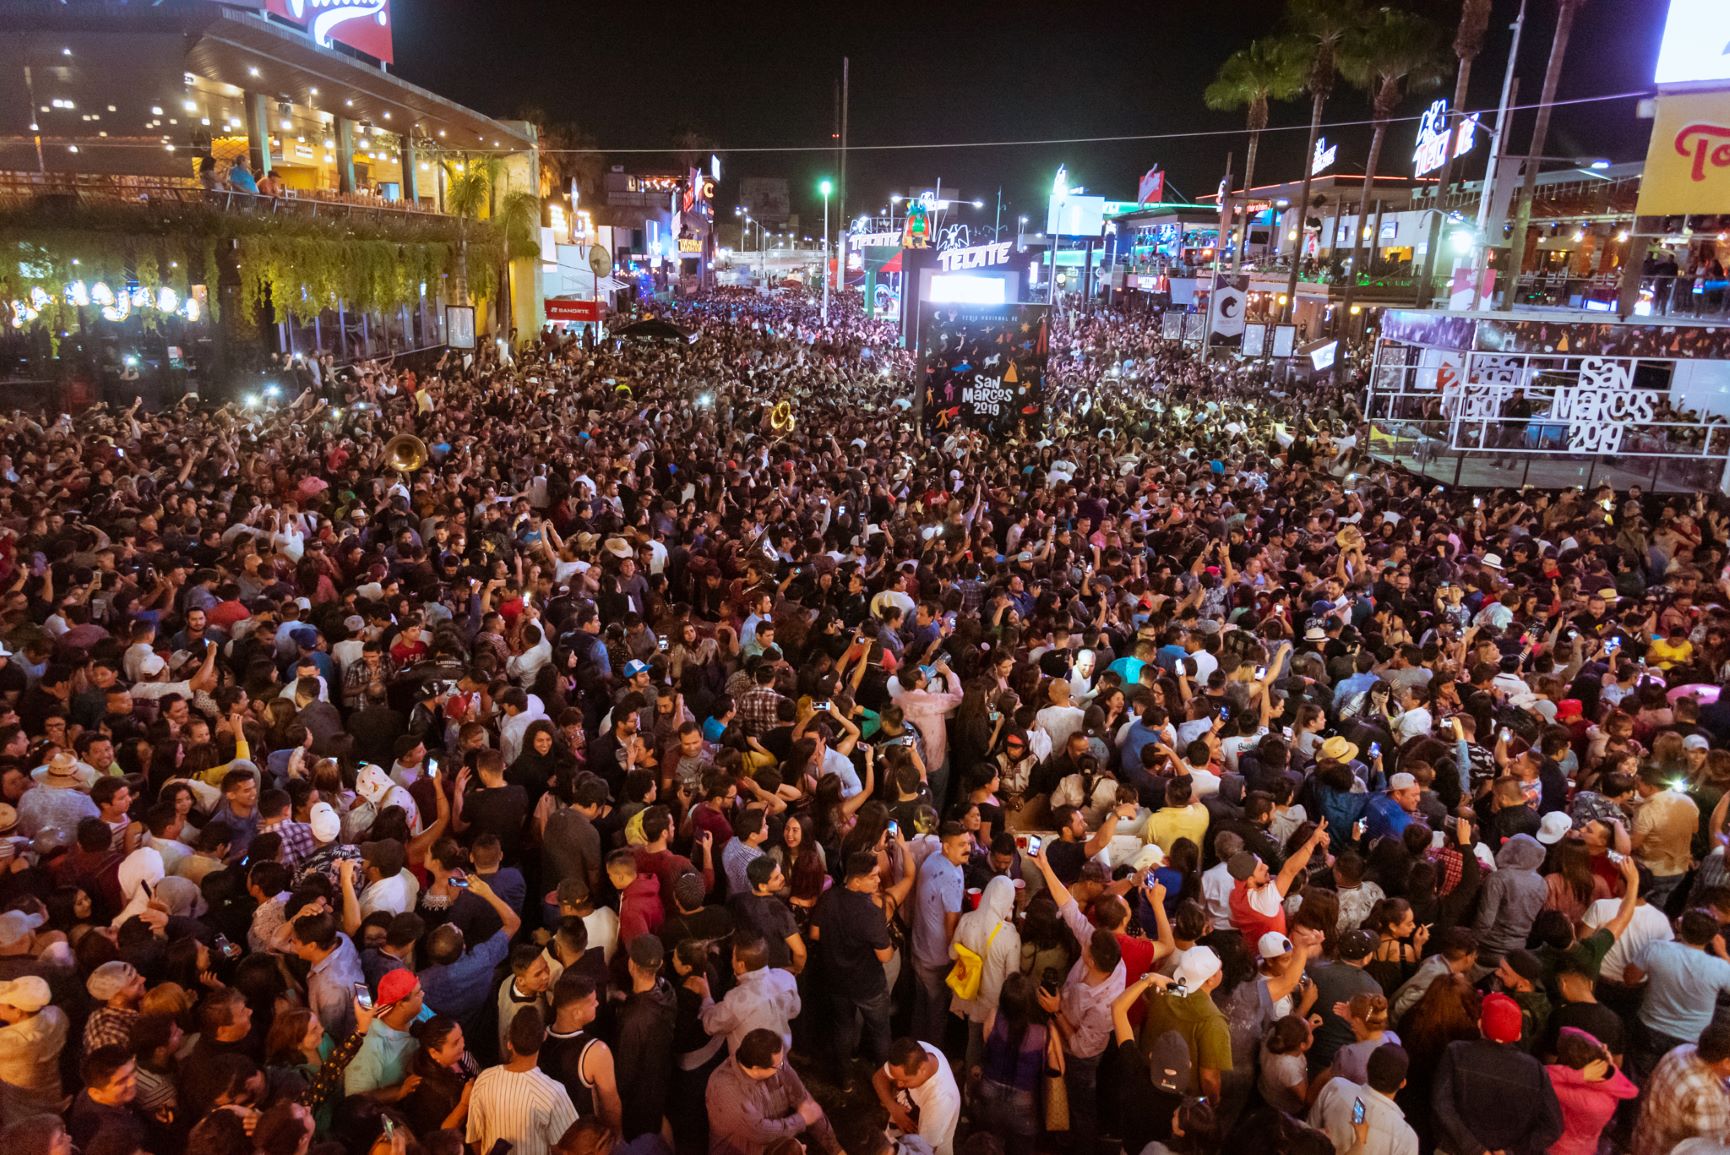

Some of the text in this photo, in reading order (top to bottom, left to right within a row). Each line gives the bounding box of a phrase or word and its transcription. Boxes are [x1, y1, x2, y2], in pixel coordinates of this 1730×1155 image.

[937, 241, 1013, 272] TECATE
[974, 402, 999, 416] 2019
[1568, 421, 1624, 454] 2019
